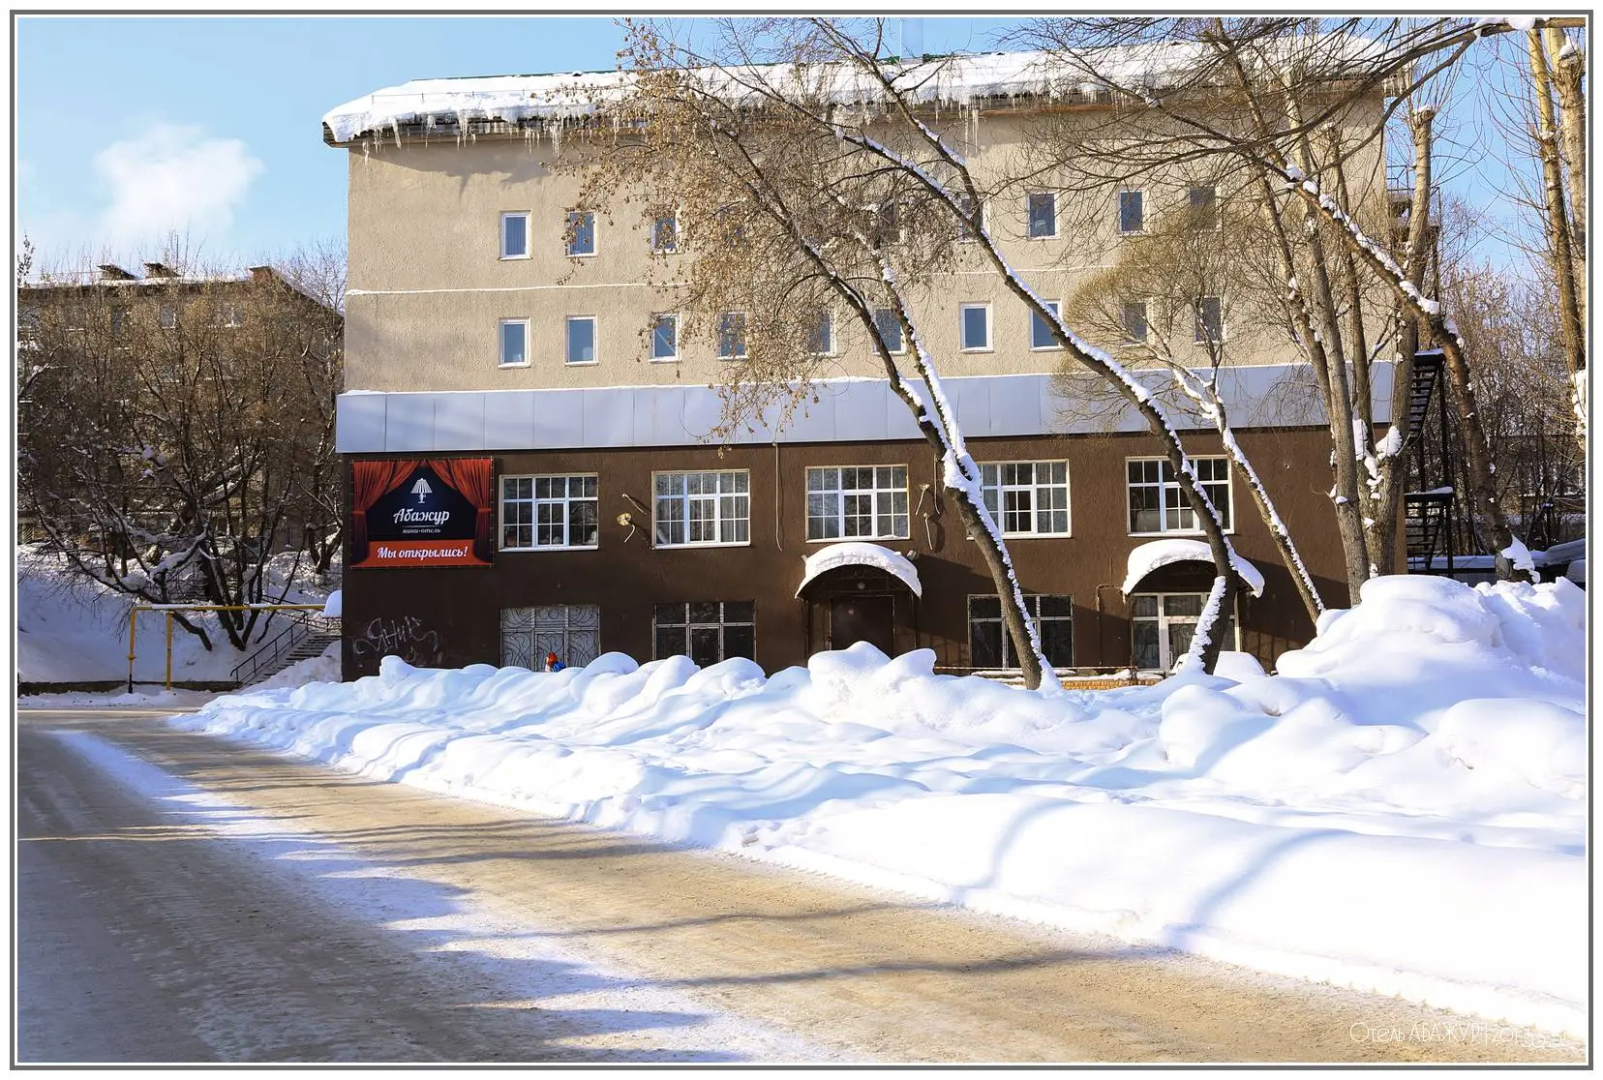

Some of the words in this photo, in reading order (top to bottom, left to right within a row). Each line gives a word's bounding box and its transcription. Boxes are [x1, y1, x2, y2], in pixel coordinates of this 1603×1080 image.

[393, 508, 450, 525] Абажур
[377, 547, 396, 558] Мы
[399, 546, 468, 561] открылись!
